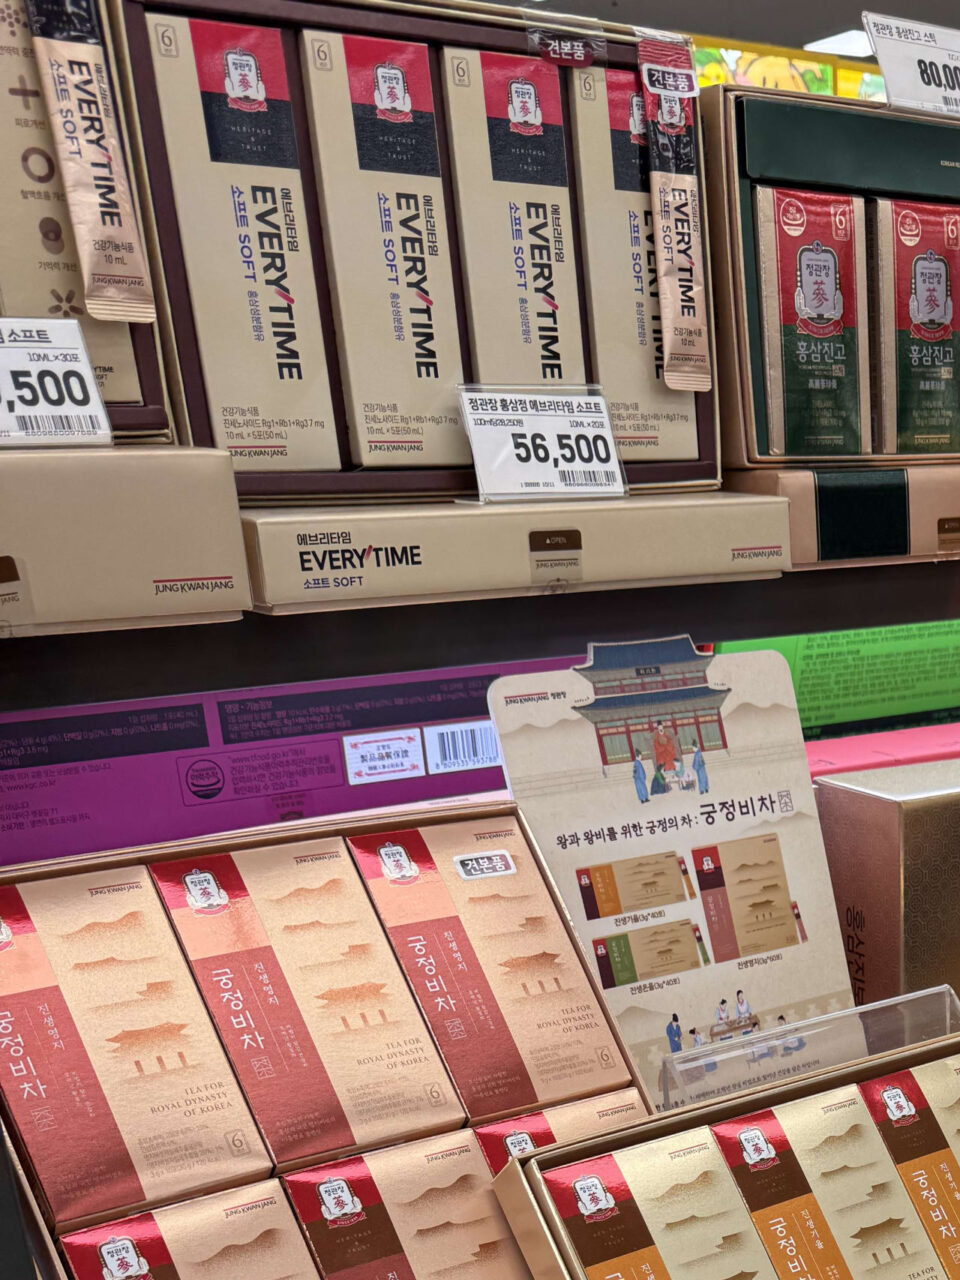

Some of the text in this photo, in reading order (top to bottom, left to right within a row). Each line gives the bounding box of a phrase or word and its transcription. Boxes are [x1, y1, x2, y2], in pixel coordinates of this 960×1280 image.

[873, 22, 893, 37] 정관장
[548, 40, 585, 61] 견본품
[651, 71, 689, 91] 견본품
[60, 108, 83, 159] SOFT
[231, 186, 249, 228] 소프트
[280, 187, 299, 252] 에브리타임
[835, 208, 847, 230] 6
[239, 234, 257, 283] SOFT
[508, 202, 528, 291] 소프트 SOFT
[104, 254, 114, 265] 10
[383, 239, 399, 285] SOFT
[805, 263, 831, 278] 정관장
[632, 253, 644, 295] SOFT
[8, 328, 52, 344] 소프트
[796, 340, 847, 364] 홍삼진고
[909, 341, 954, 366] 홍삼진고
[0, 369, 91, 413] ,500
[468, 398, 603, 414] 정관장 홍삼정 에브리타임 소프트
[511, 432, 611, 469] 56,500
[296, 531, 352, 546] 에브리타임
[303, 575, 364, 589] 소프트 SOFT
[556, 793, 777, 850] 왕과 왕비를 위한 궁정의 차 궁정비차
[463, 854, 506, 874] 견본품
[407, 934, 456, 1013] 궁정비차
[212, 967, 265, 1050] 궁정비차
[911, 1167, 957, 1240] 궁정비차
[106, 1245, 131, 1259] 정관장
